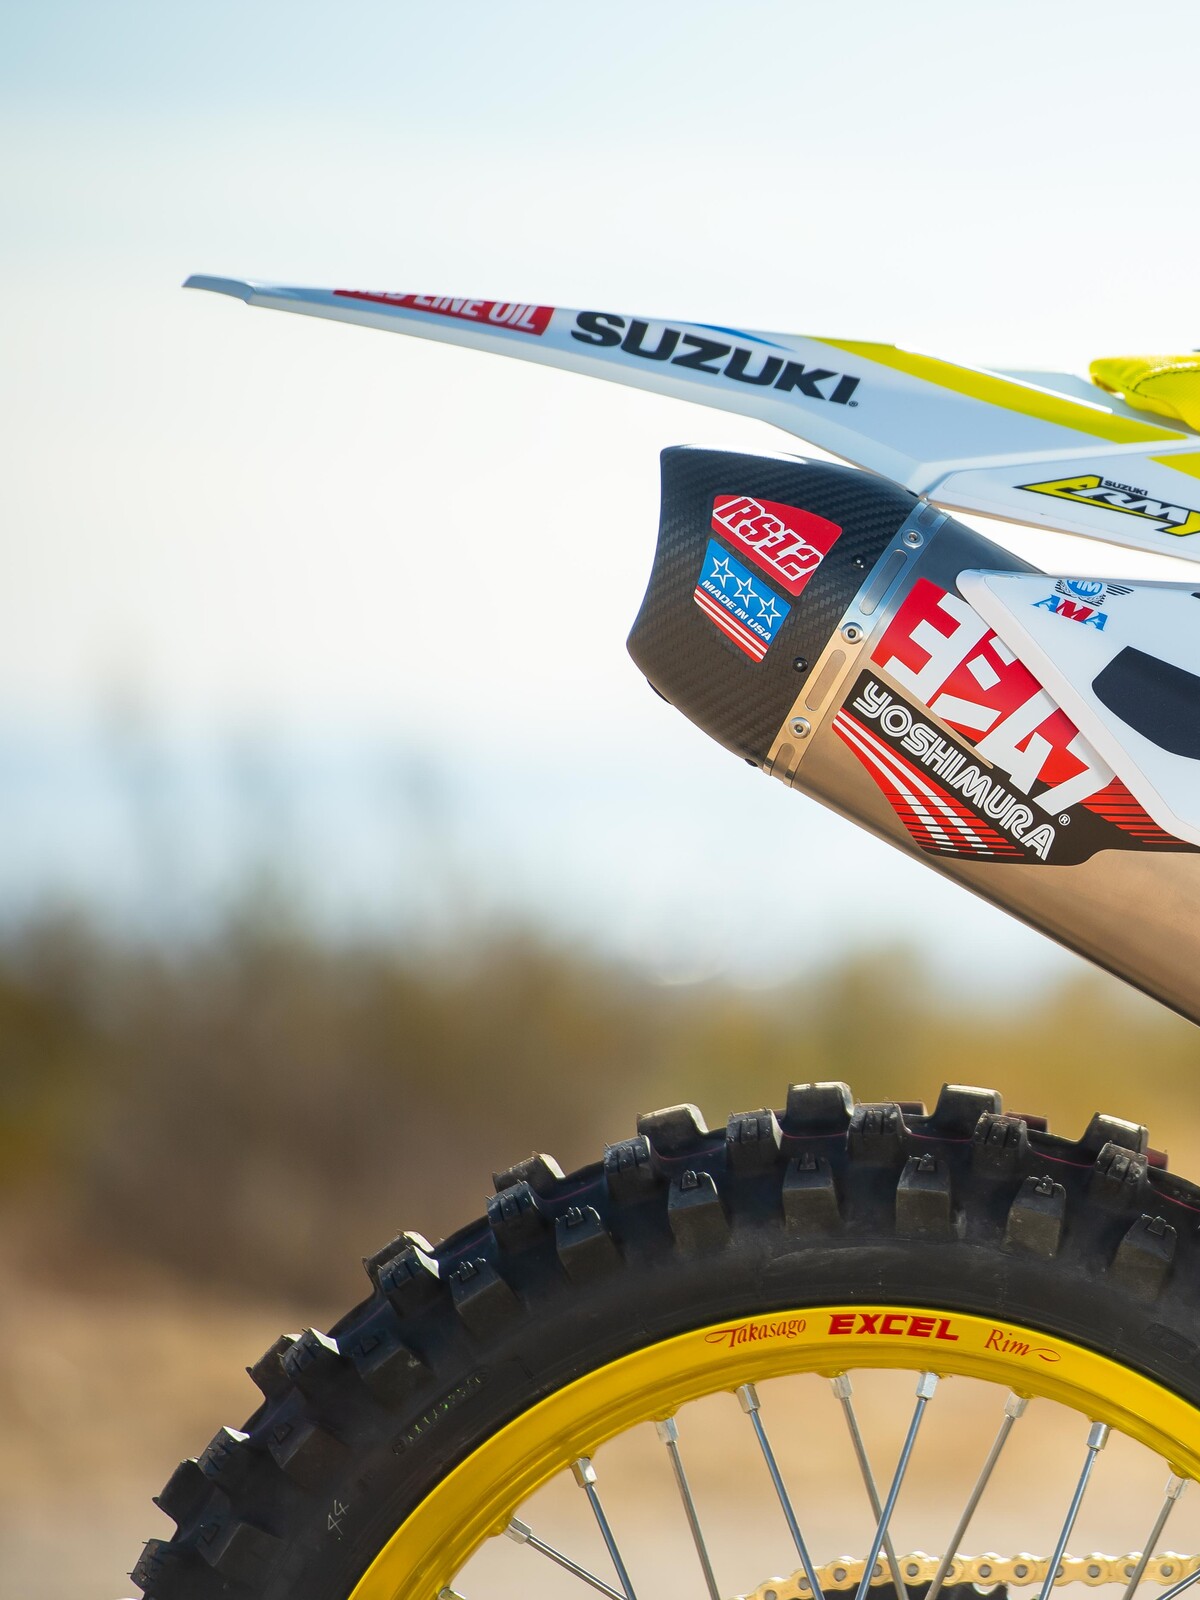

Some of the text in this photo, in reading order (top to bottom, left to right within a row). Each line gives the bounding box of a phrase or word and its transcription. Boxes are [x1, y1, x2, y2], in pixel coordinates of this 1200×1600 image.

[488, 303, 537, 329] OIL
[570, 311, 861, 405] SUZUKI
[1104, 479, 1148, 497] SUZUKI
[701, 580, 772, 641] MADE IN USA
[1032, 594, 1108, 631] AMA
[853, 681, 1056, 861] YOSHIMURA
[704, 1313, 1062, 1362] Takasago EXCEL Rim
